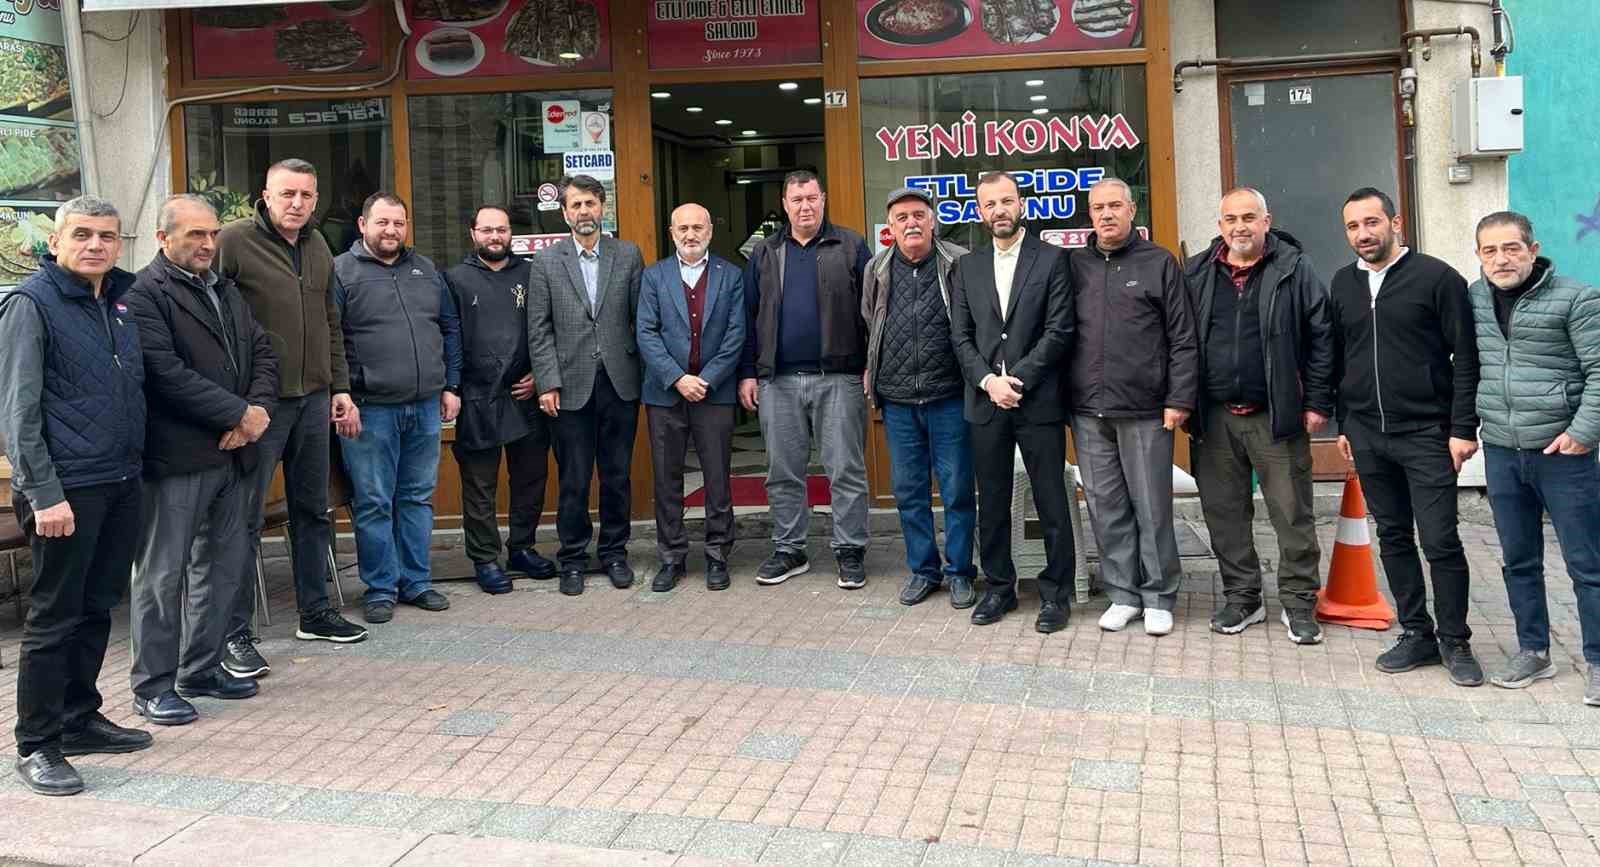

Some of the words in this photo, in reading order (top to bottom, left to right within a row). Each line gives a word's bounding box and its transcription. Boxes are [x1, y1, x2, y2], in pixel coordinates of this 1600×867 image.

[705, 20, 757, 40] SALONU
[704, 49, 731, 62] Since
[826, 92, 845, 104] 17
[985, 113, 1139, 155] KONYA
[565, 154, 612, 168] SETCARD
[904, 174, 986, 197] ETL
[937, 195, 1075, 224] SANU
